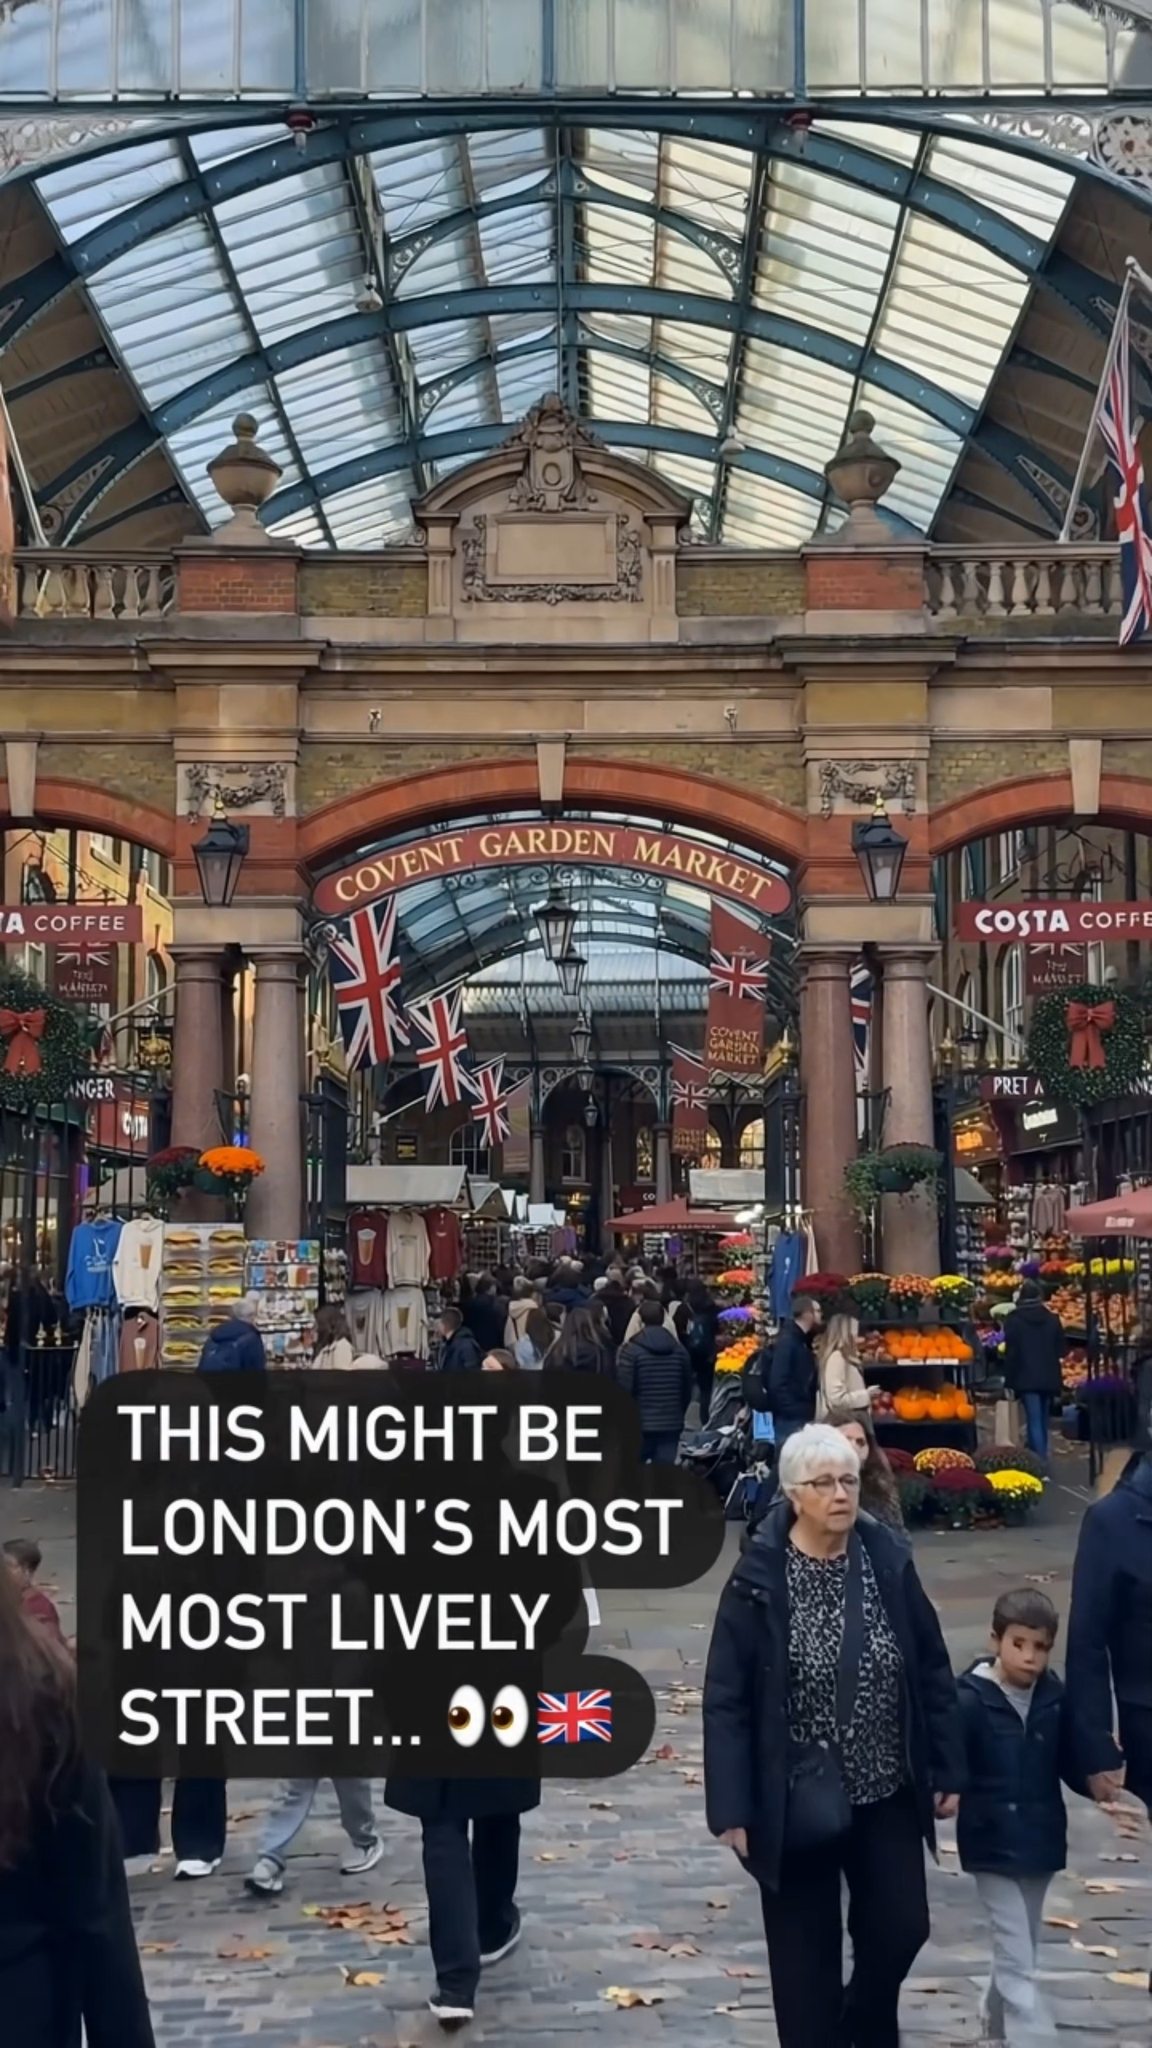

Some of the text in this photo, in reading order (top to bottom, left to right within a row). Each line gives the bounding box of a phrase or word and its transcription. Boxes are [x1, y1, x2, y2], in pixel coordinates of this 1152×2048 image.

[334, 829, 772, 902] COVENT GARDEN MARKET
[34, 915, 125, 932] COFFEE
[974, 909, 1070, 936] COSTA
[710, 1026, 758, 1041] COVENT
[709, 1038, 760, 1053] GARDEN
[708, 1051, 758, 1065] MARKET
[992, 1075, 1029, 1096] PRET
